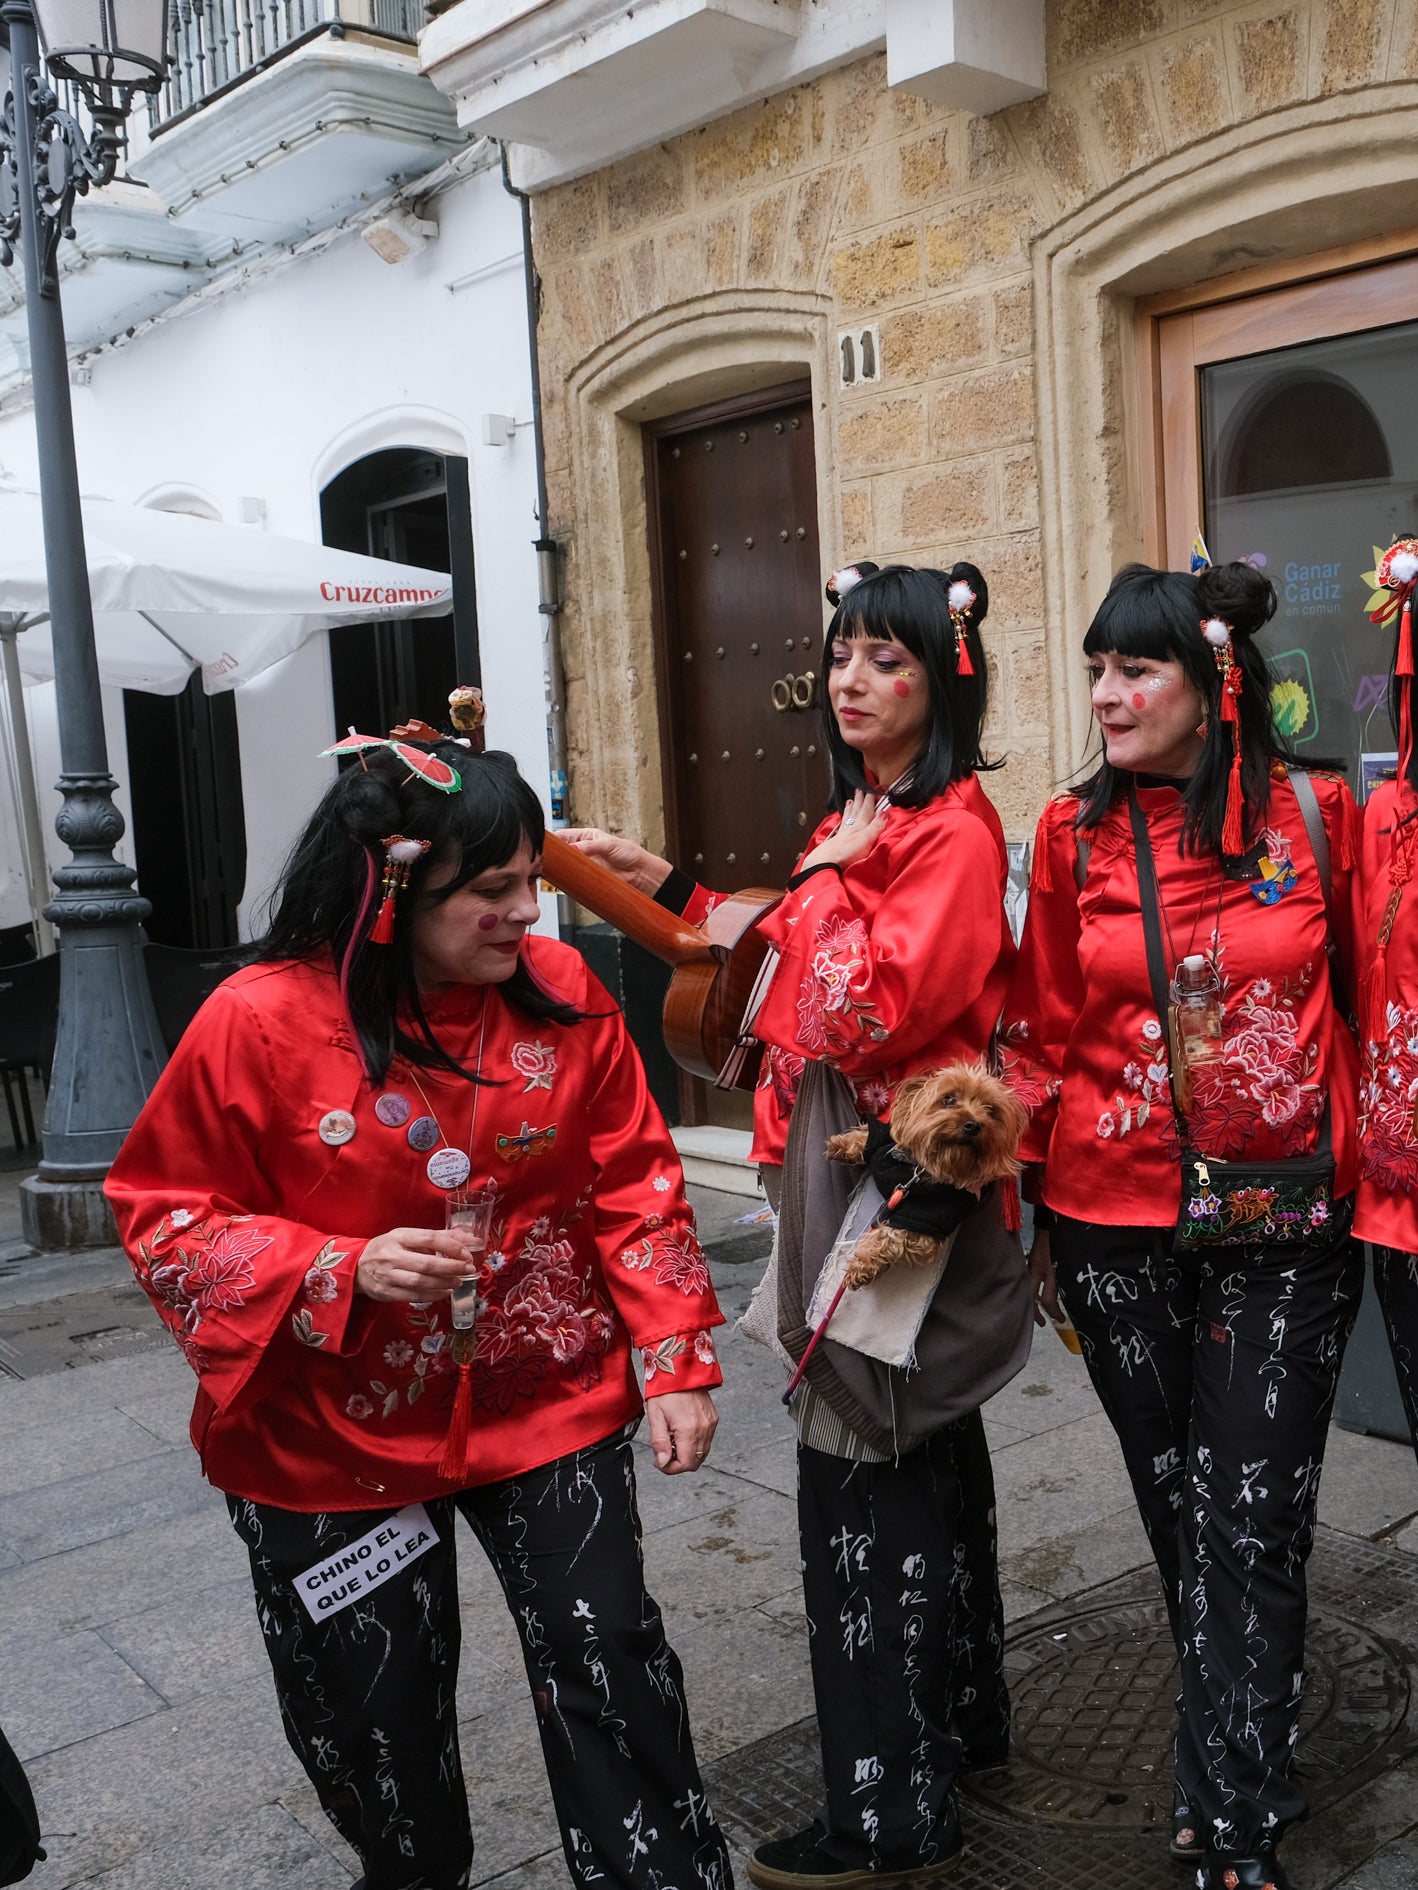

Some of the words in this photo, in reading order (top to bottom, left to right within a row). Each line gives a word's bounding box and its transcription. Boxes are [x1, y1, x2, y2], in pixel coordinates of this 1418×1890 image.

[841, 330, 876, 384] 11
[1285, 561, 1342, 582] Ganar
[1285, 580, 1342, 604] Cádiz
[1286, 606, 1300, 617] en
[306, 1544, 372, 1590] CHINO
[375, 1527, 401, 1548] EL
[317, 1577, 362, 1610] QUE
[365, 1558, 391, 1582] LO
[394, 1531, 430, 1561] LEA
